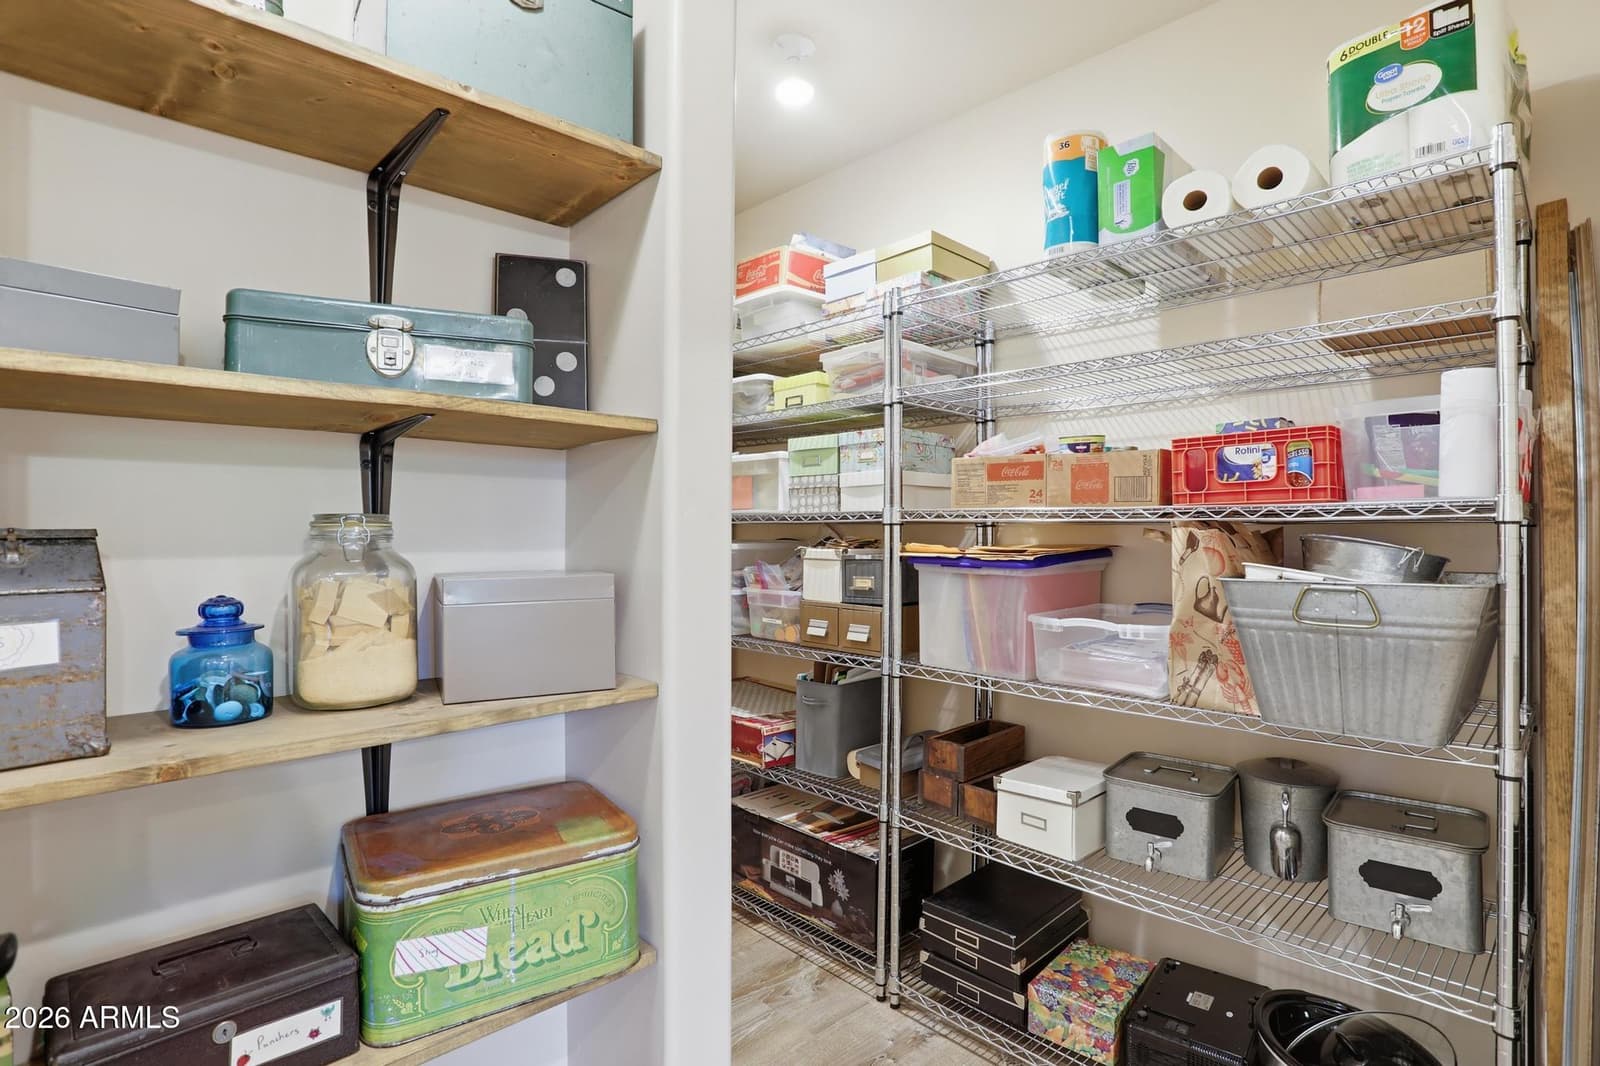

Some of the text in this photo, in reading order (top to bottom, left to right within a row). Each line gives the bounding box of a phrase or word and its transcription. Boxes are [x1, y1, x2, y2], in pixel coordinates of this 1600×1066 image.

[1433, 20, 1471, 37] Split Sheets
[1340, 30, 1389, 62] 6 DOUBLE
[1060, 140, 1070, 150] 36
[1235, 446, 1260, 456] Rotini
[1001, 465, 1030, 478] Coca-Cola
[1029, 489, 1043, 499] 24
